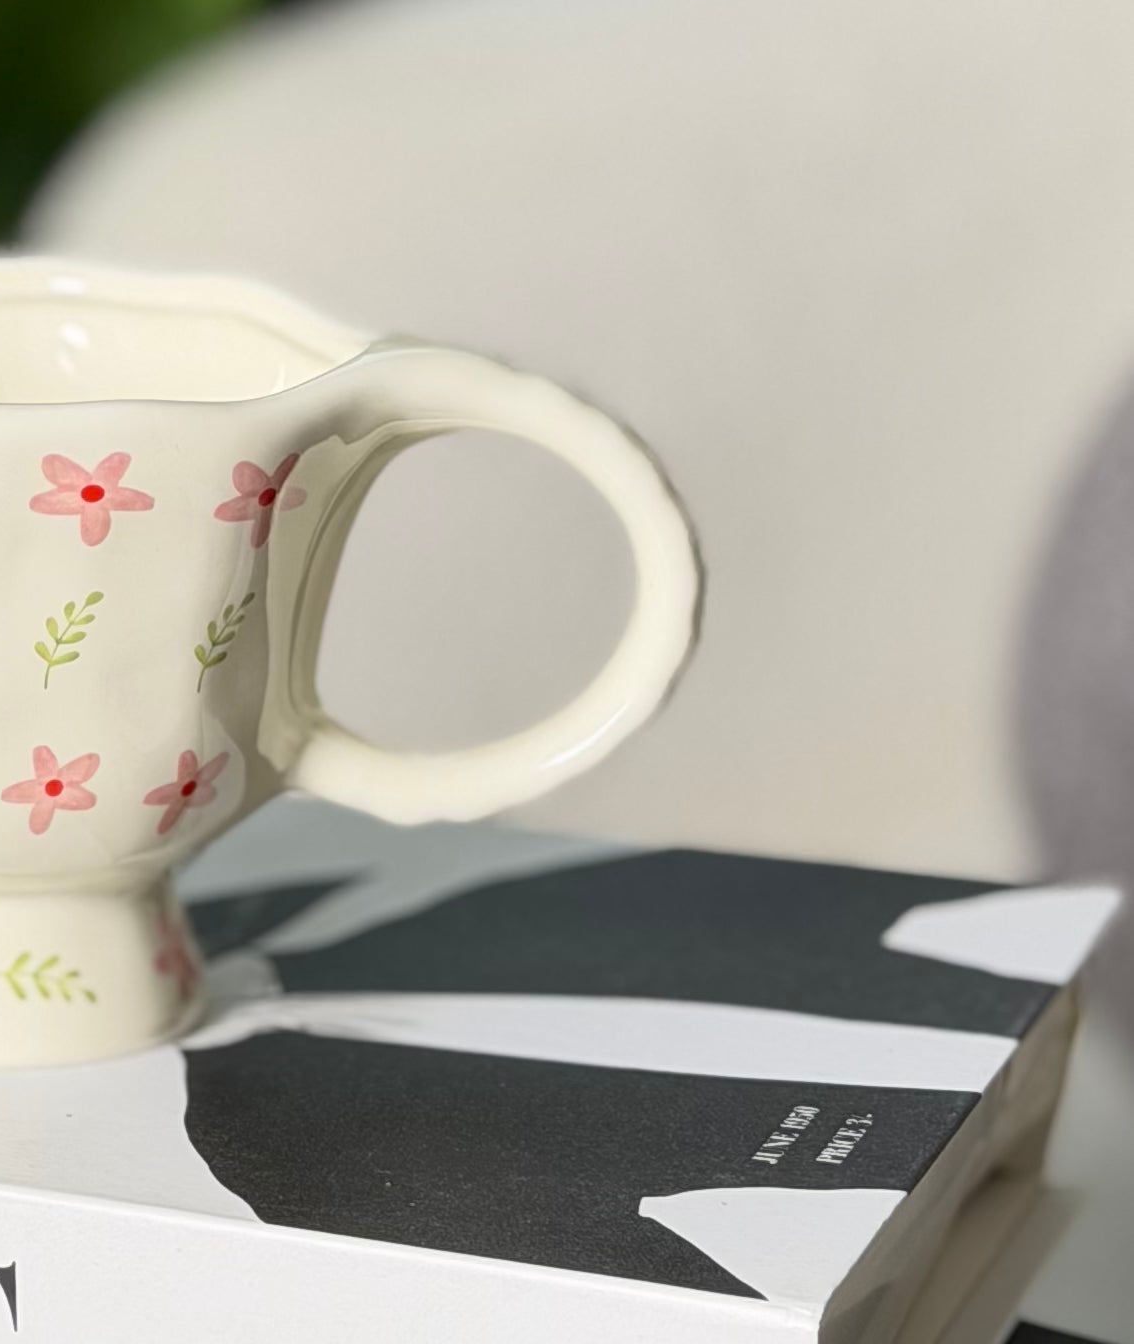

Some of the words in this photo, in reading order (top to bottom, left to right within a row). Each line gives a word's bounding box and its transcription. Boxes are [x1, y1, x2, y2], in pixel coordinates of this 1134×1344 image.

[751, 1130, 800, 1165] JUNE
[779, 1105, 821, 1131] 1950
[815, 1126, 867, 1165] PRICE
